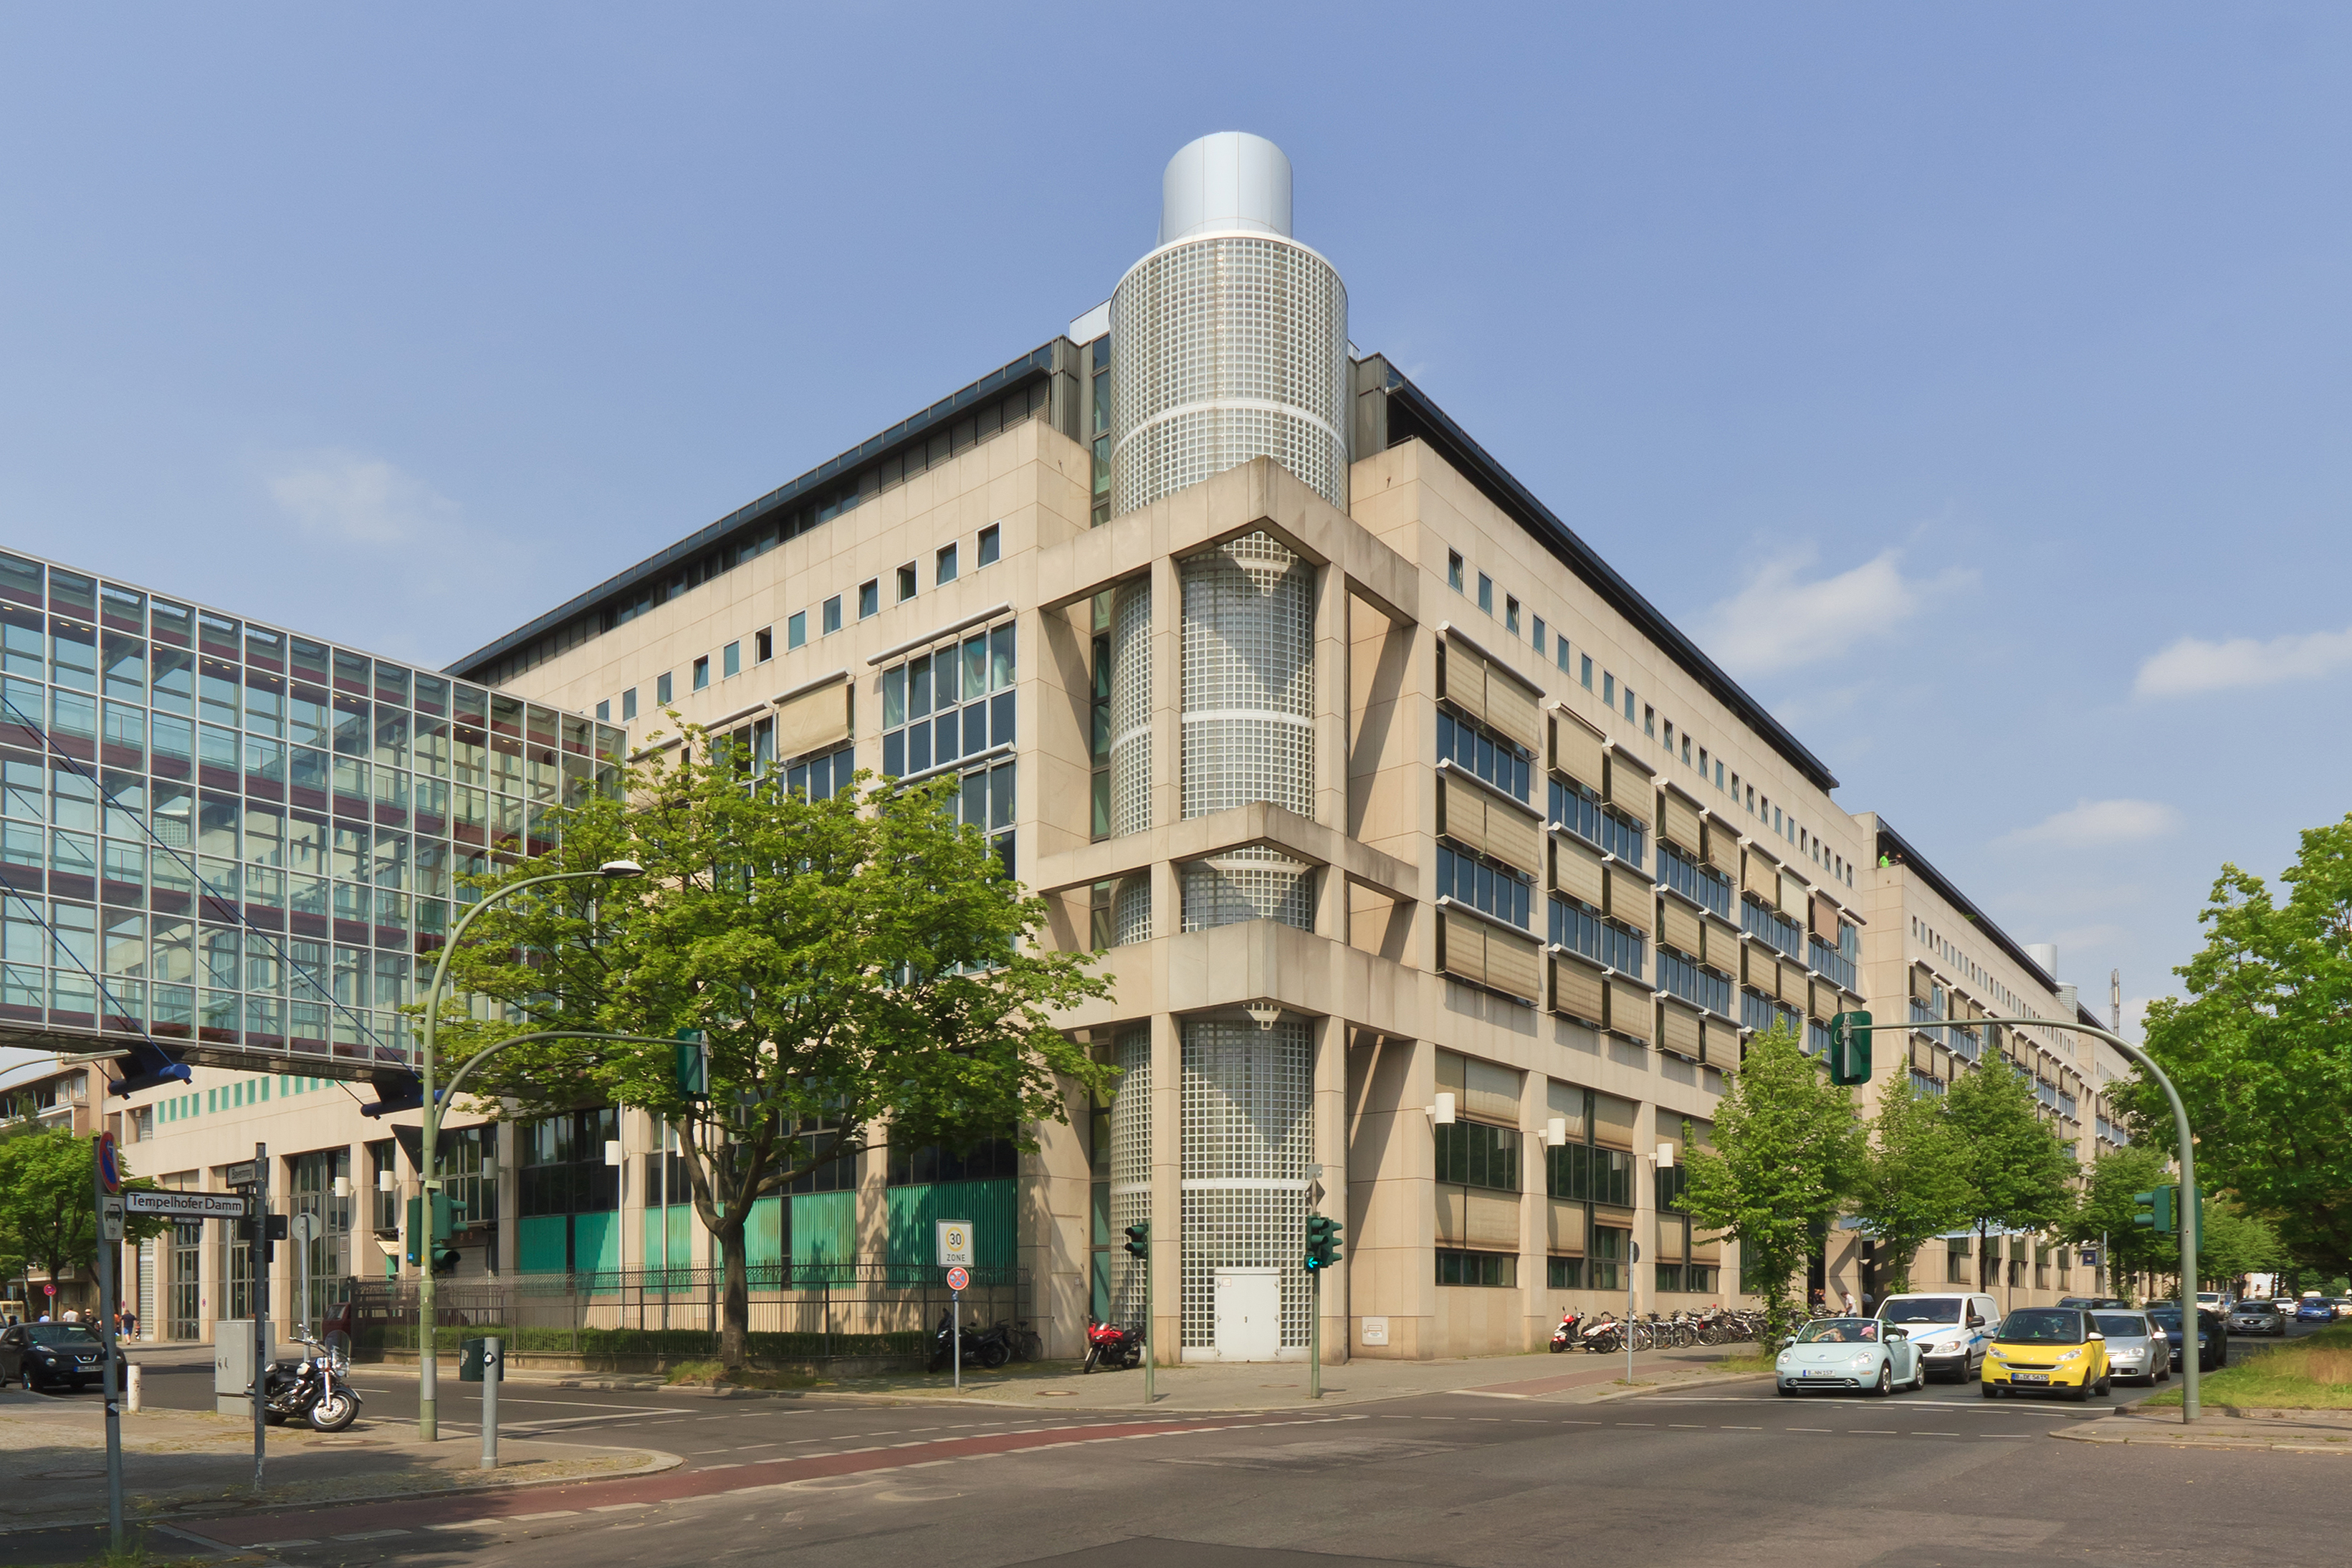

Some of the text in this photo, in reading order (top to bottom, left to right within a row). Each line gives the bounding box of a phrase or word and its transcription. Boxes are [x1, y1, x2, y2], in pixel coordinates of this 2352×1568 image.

[130, 1193, 242, 1211] Tempelhofer Damm
[950, 1233, 962, 1246] 30
[947, 1253, 966, 1262] ZONE
